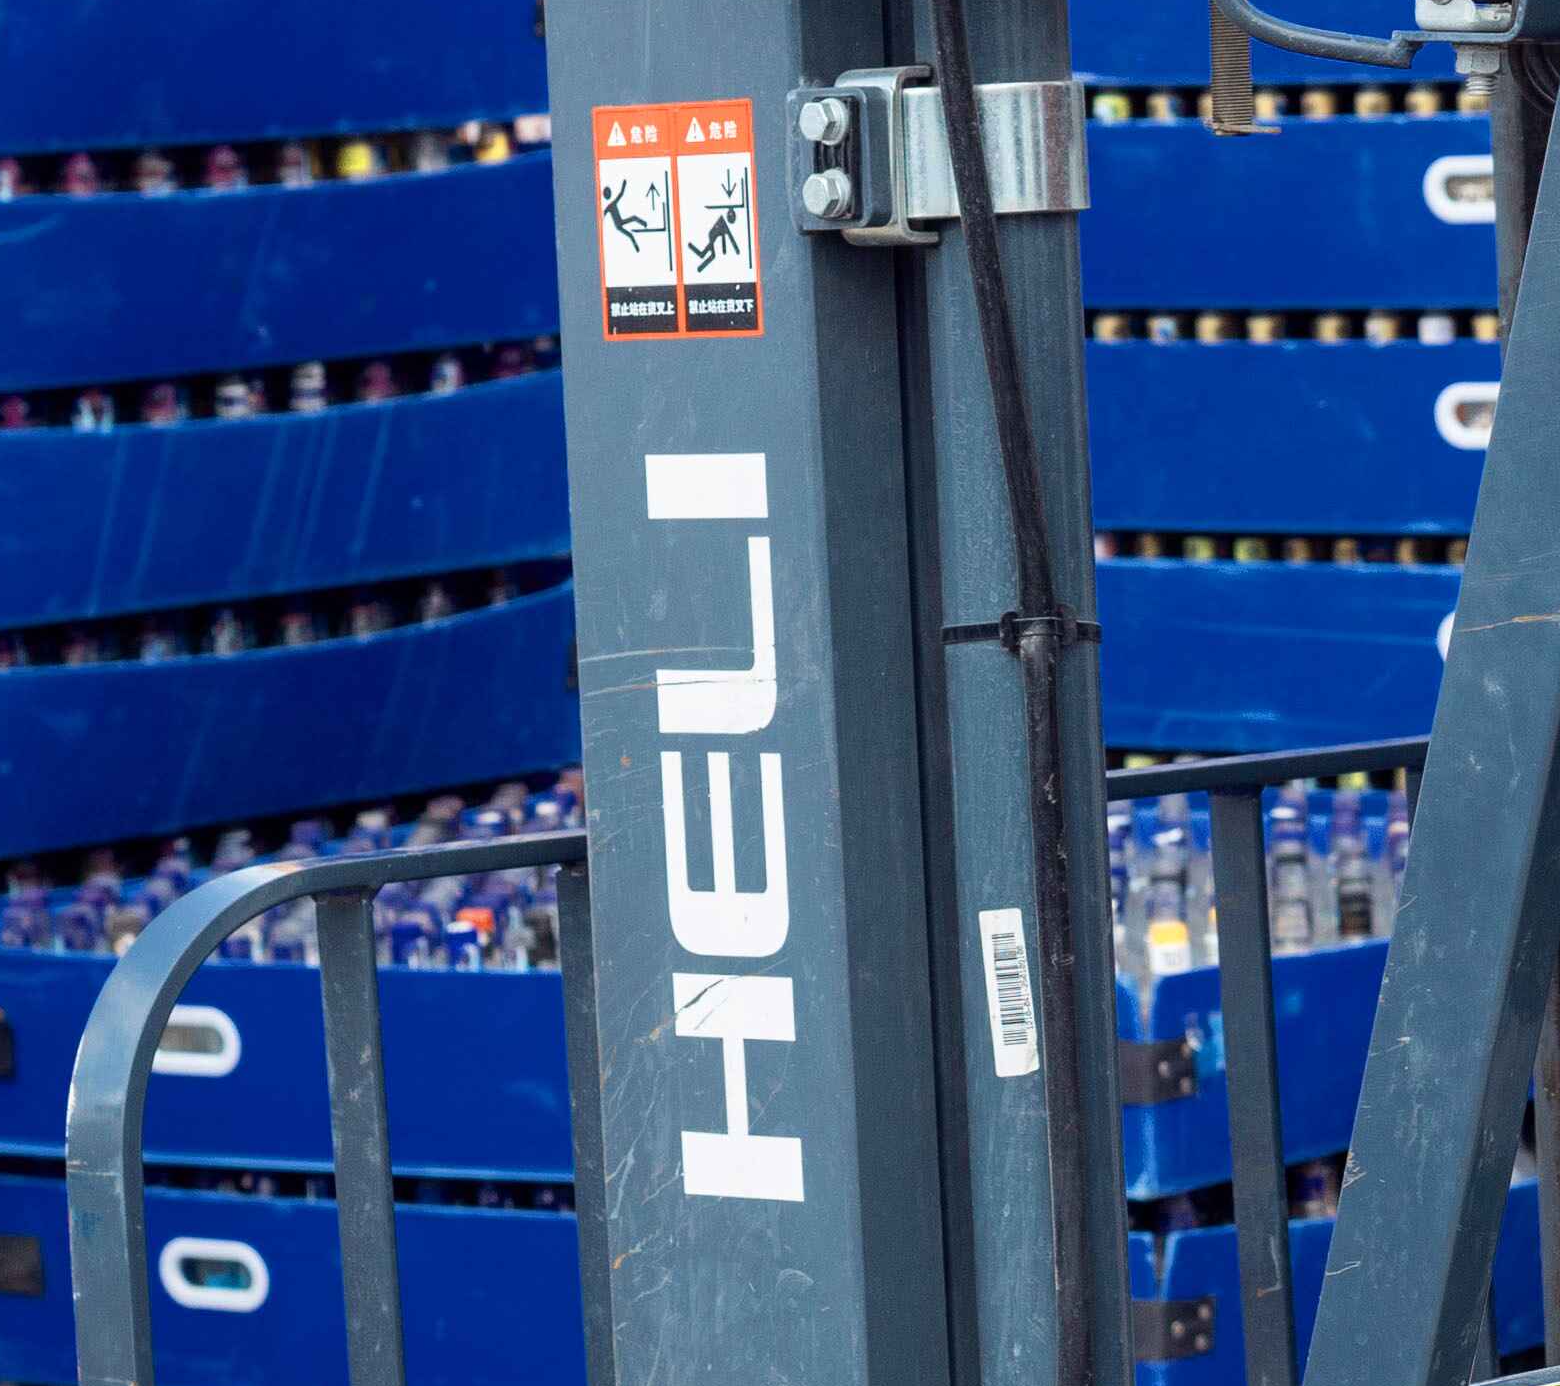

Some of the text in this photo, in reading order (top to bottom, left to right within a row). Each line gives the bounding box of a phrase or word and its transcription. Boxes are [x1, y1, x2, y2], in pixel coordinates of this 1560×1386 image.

[630, 125, 658, 144] 危险
[709, 120, 737, 140] 危险
[644, 453, 806, 1202] HELI
